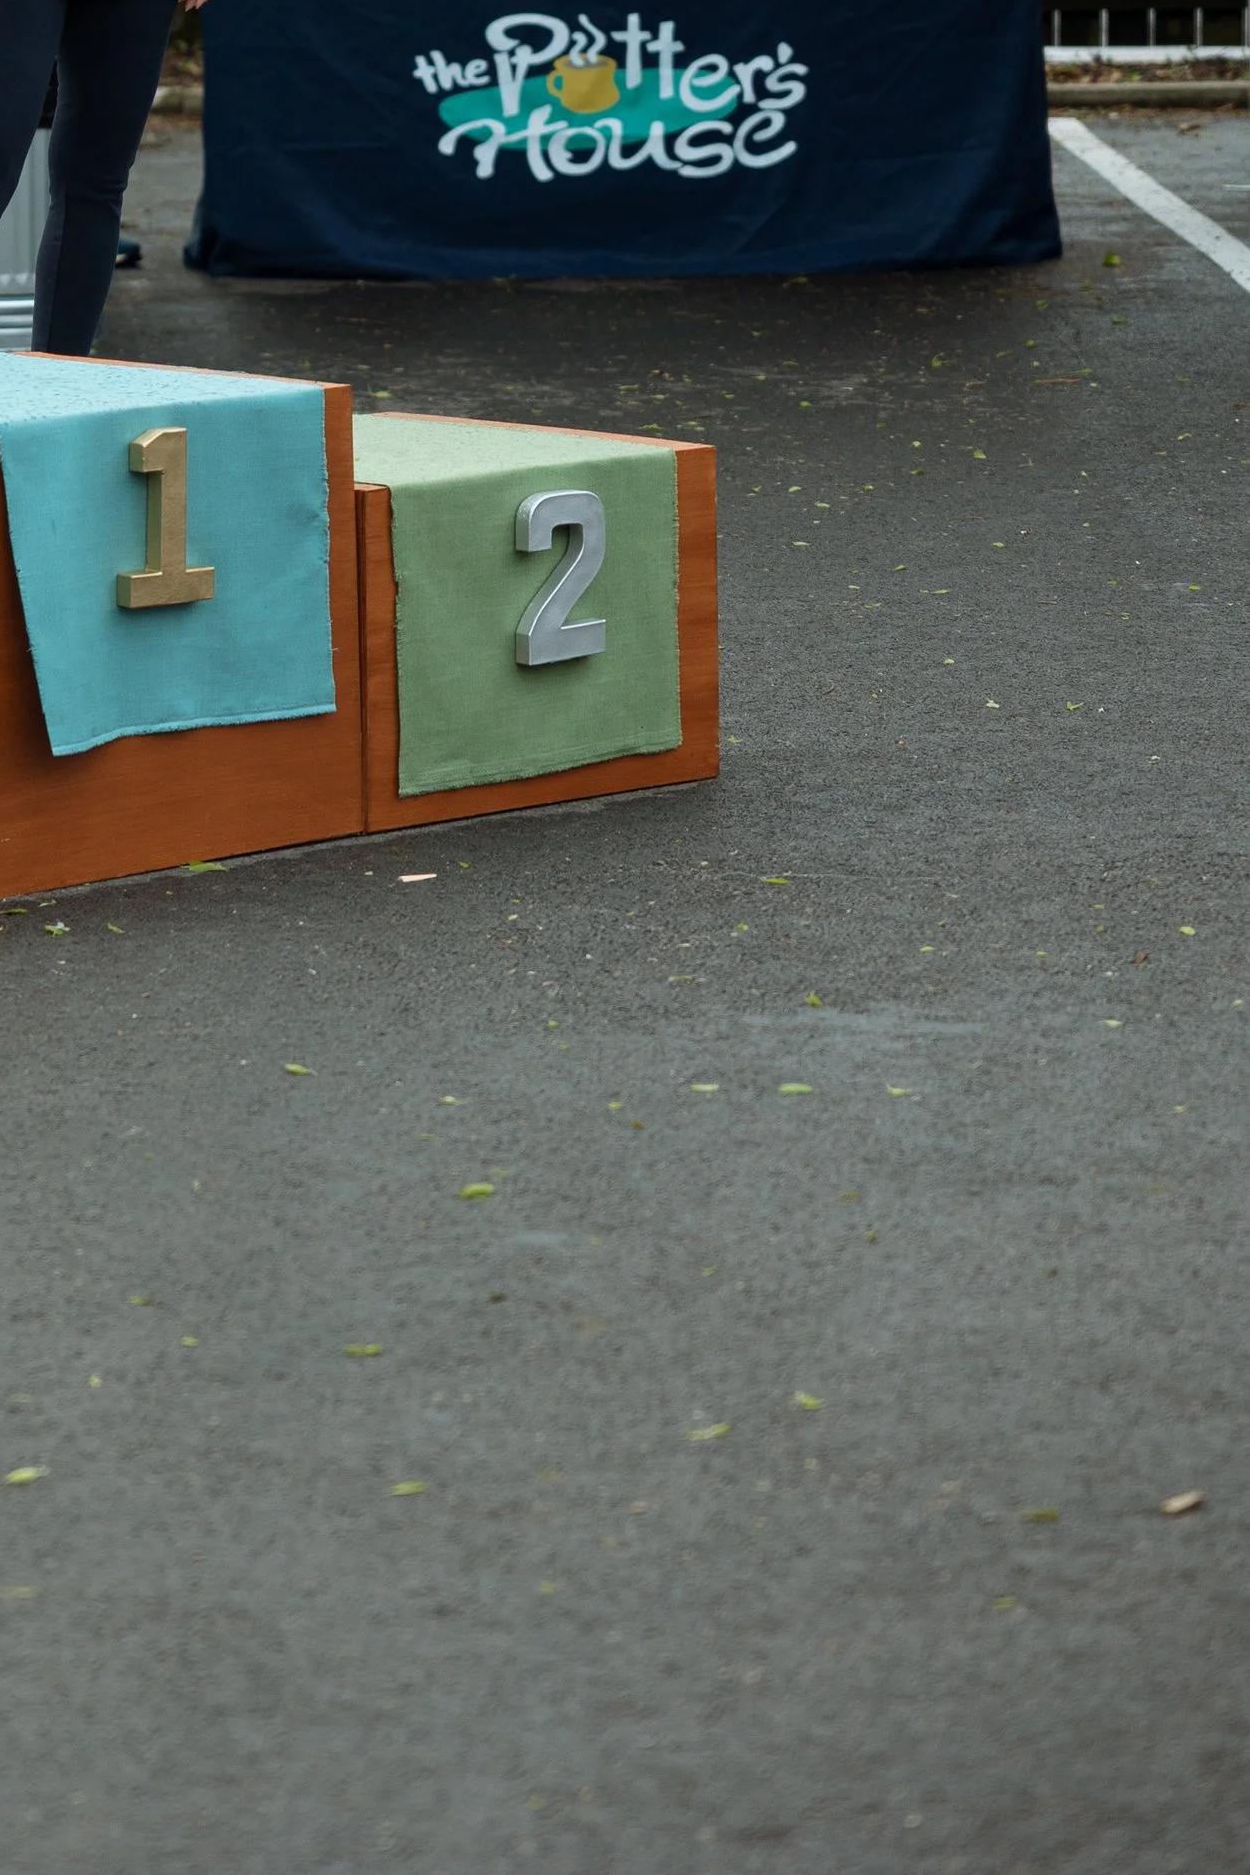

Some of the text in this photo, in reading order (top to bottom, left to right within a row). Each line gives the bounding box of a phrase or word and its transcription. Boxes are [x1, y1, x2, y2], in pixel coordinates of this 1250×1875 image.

[412, 50, 490, 94] the
[117, 426, 215, 610] 1
[515, 490, 607, 666] 2
